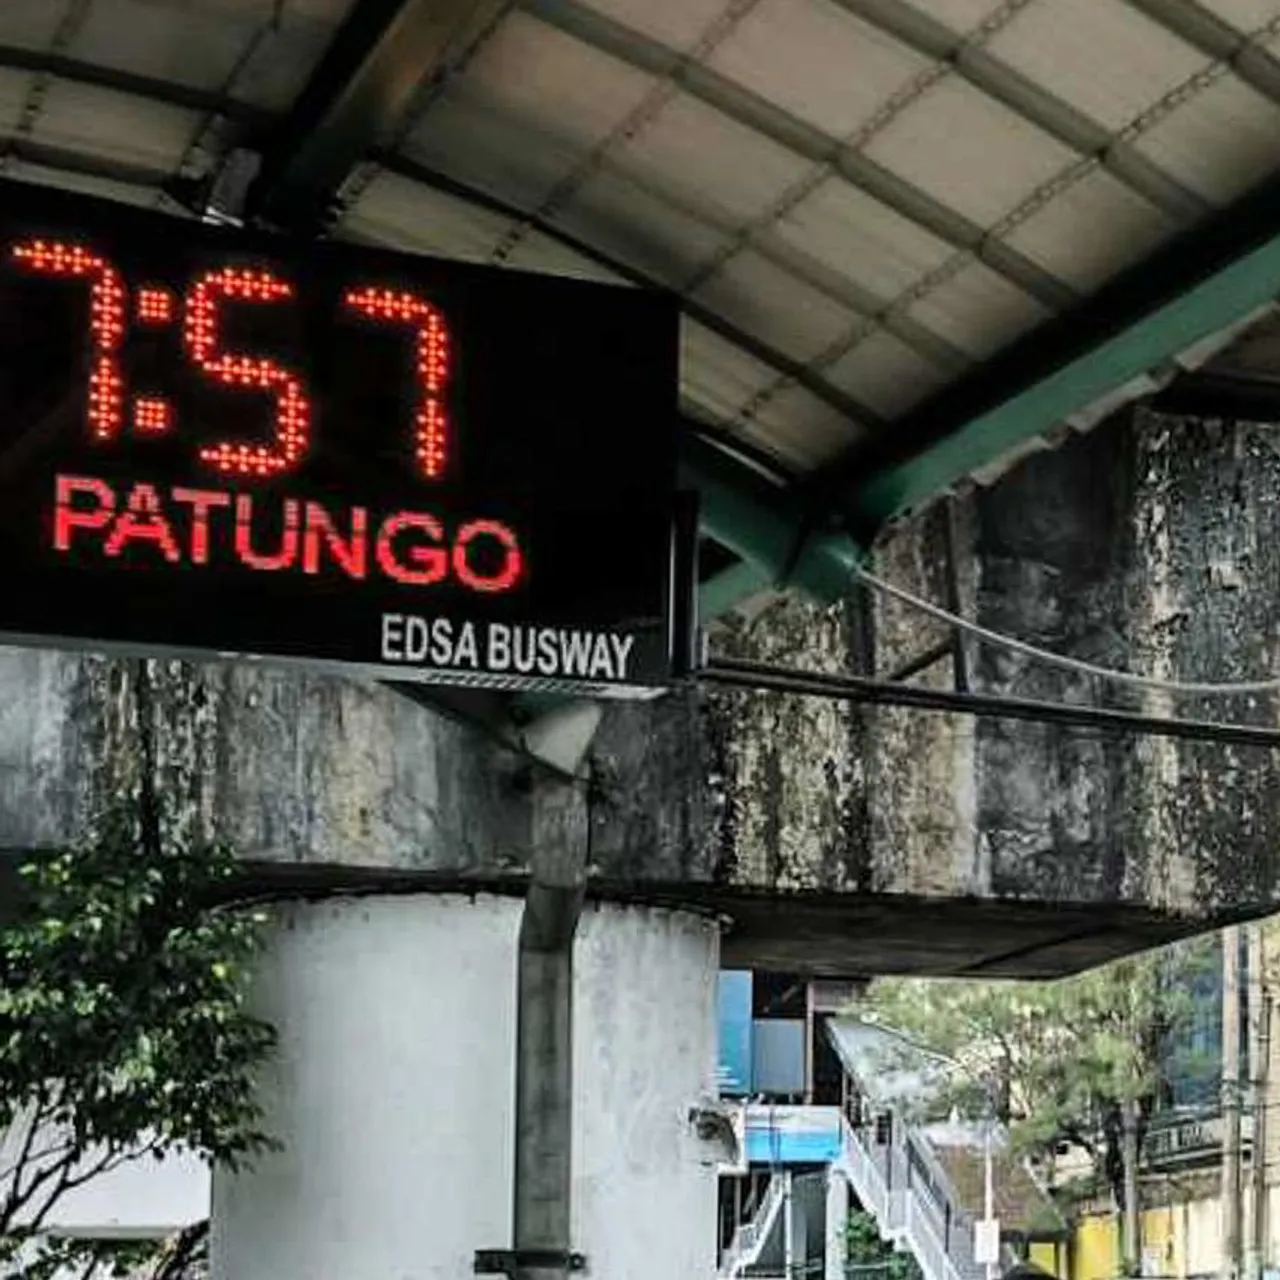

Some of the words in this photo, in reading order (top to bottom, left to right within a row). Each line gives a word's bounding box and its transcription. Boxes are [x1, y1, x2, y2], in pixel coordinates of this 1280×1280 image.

[53, 474, 523, 591] PATUNGO
[381, 612, 480, 668] EDSA
[488, 624, 635, 680] BUSWAY
